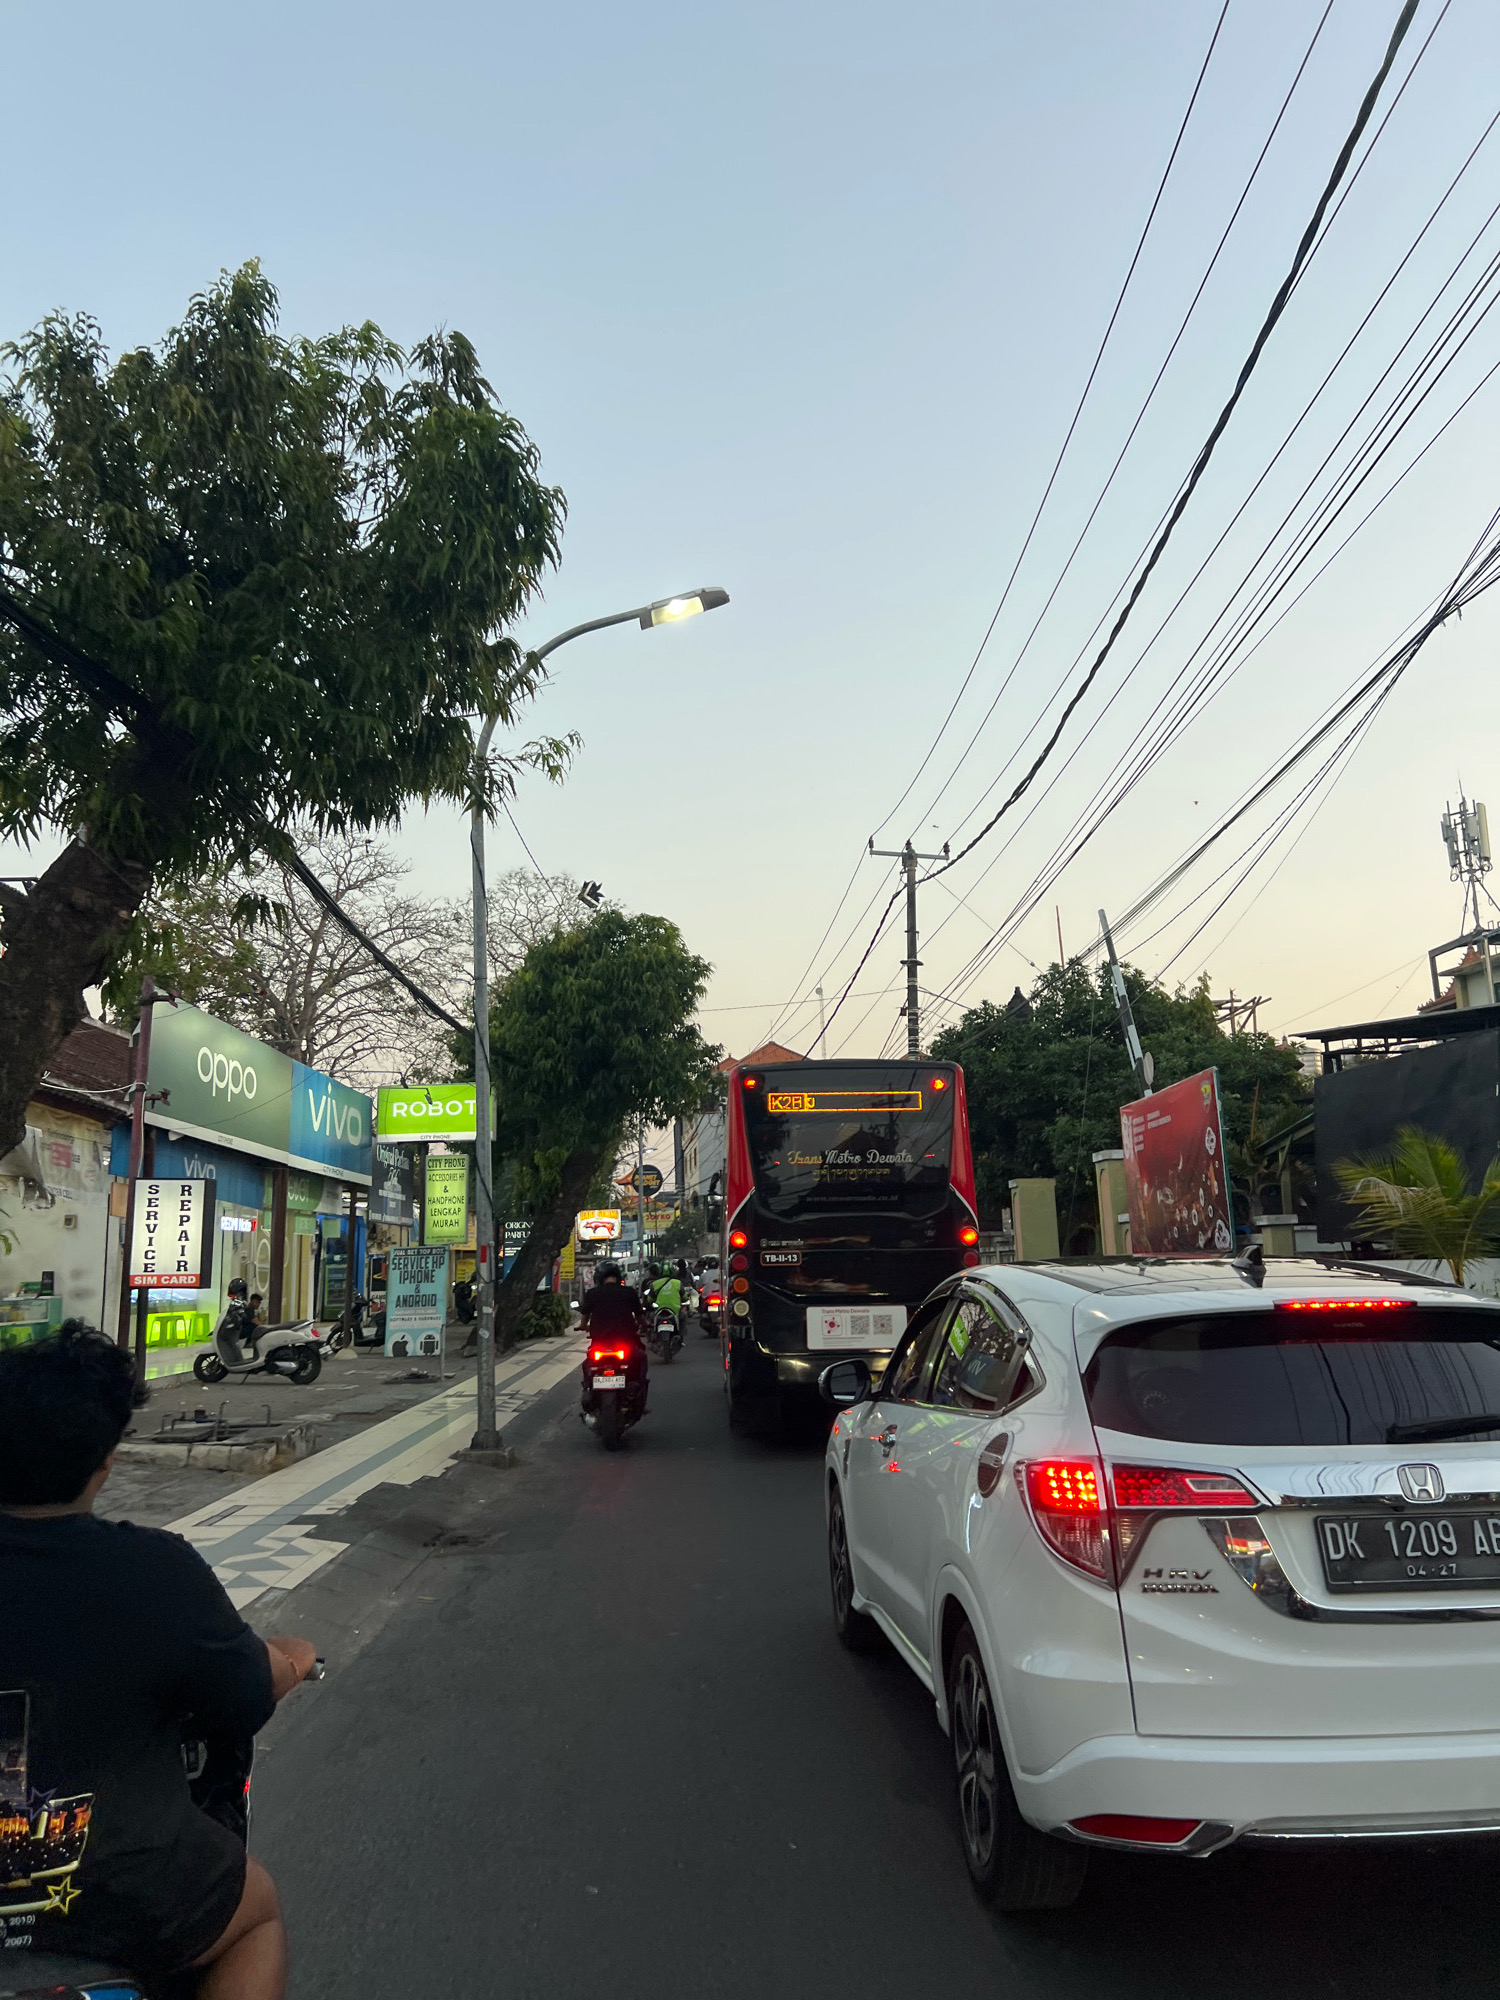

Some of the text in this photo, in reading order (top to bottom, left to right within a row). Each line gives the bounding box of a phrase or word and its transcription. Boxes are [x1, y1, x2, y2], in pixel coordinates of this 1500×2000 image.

[197, 1046, 257, 1102] oppo
[308, 1082, 362, 1146] vivo
[392, 1099, 477, 1118] ROBOT
[427, 1157, 466, 1169] CITY PHONE
[787, 1149, 914, 1165] Trans Metro Dewata
[443, 1185, 449, 1193] &
[427, 1196, 465, 1205] HANDPHONE
[430, 1207, 462, 1217] LENGKAP
[143, 1184, 160, 1273] SERVICE
[176, 1184, 193, 1272] REPAIR
[432, 1219, 460, 1228] MURAH
[392, 1256, 445, 1271] SERVICE HP
[134, 1275, 196, 1285] SIM CARD
[398, 1269, 436, 1285] IPHONE
[395, 1293, 438, 1308] ANDROID
[1323, 1522, 1365, 1560] DK
[1384, 1520, 1458, 1558] 1209
[1142, 1583, 1220, 1593] HONDA
